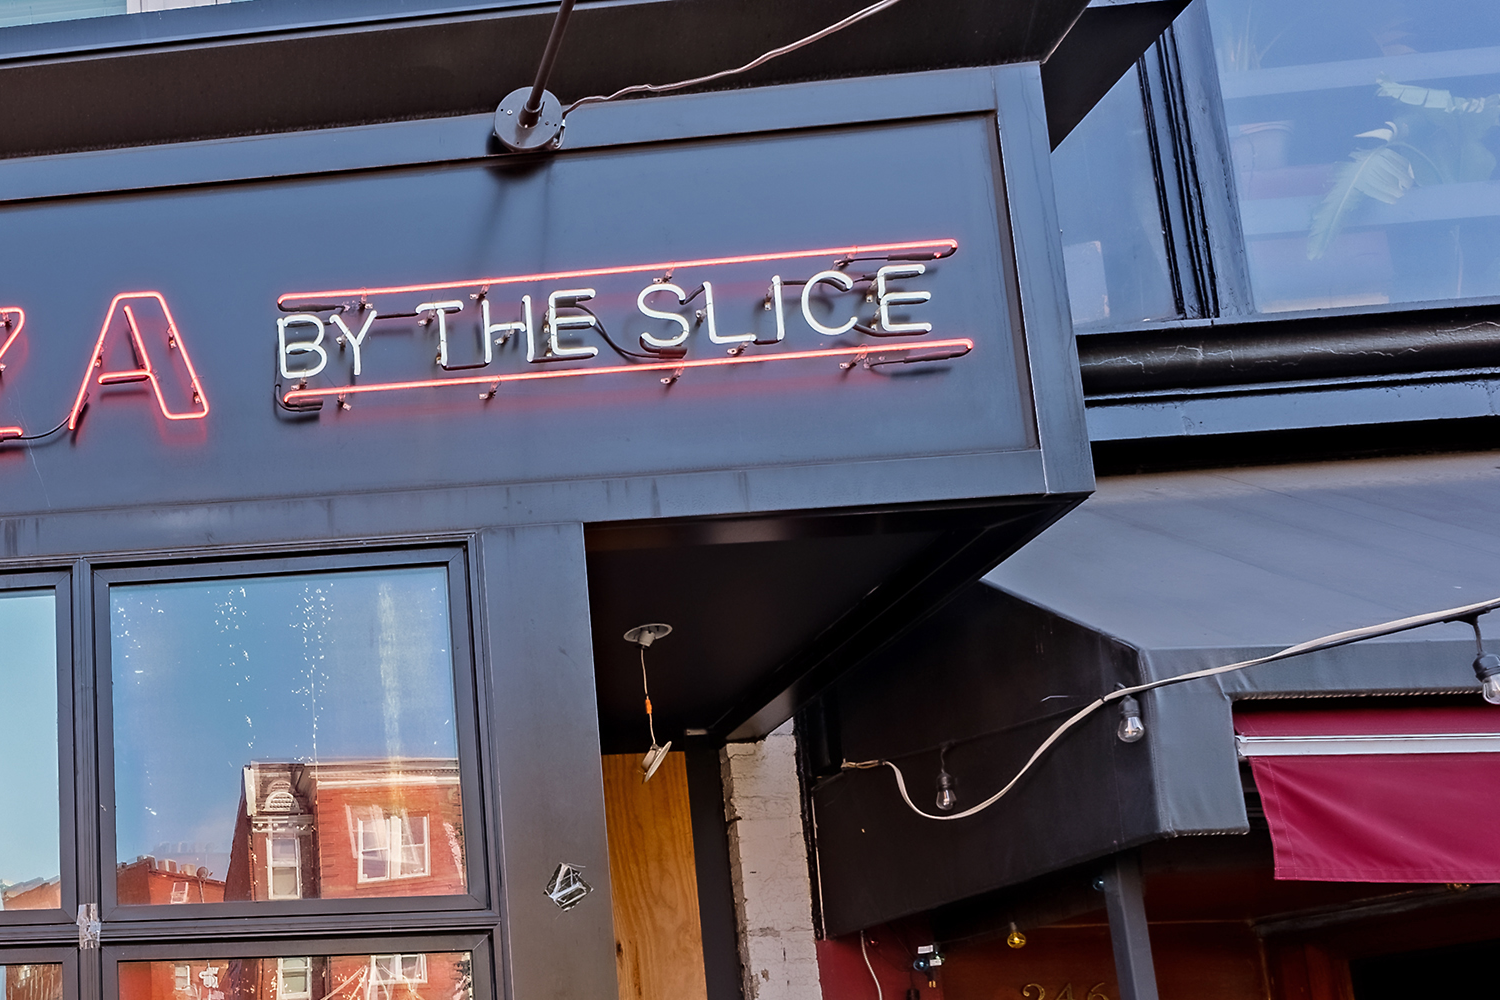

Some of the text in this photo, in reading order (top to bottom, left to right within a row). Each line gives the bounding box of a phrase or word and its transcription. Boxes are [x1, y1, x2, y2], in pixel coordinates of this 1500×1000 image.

[277, 264, 934, 379] BY THE SLICE
